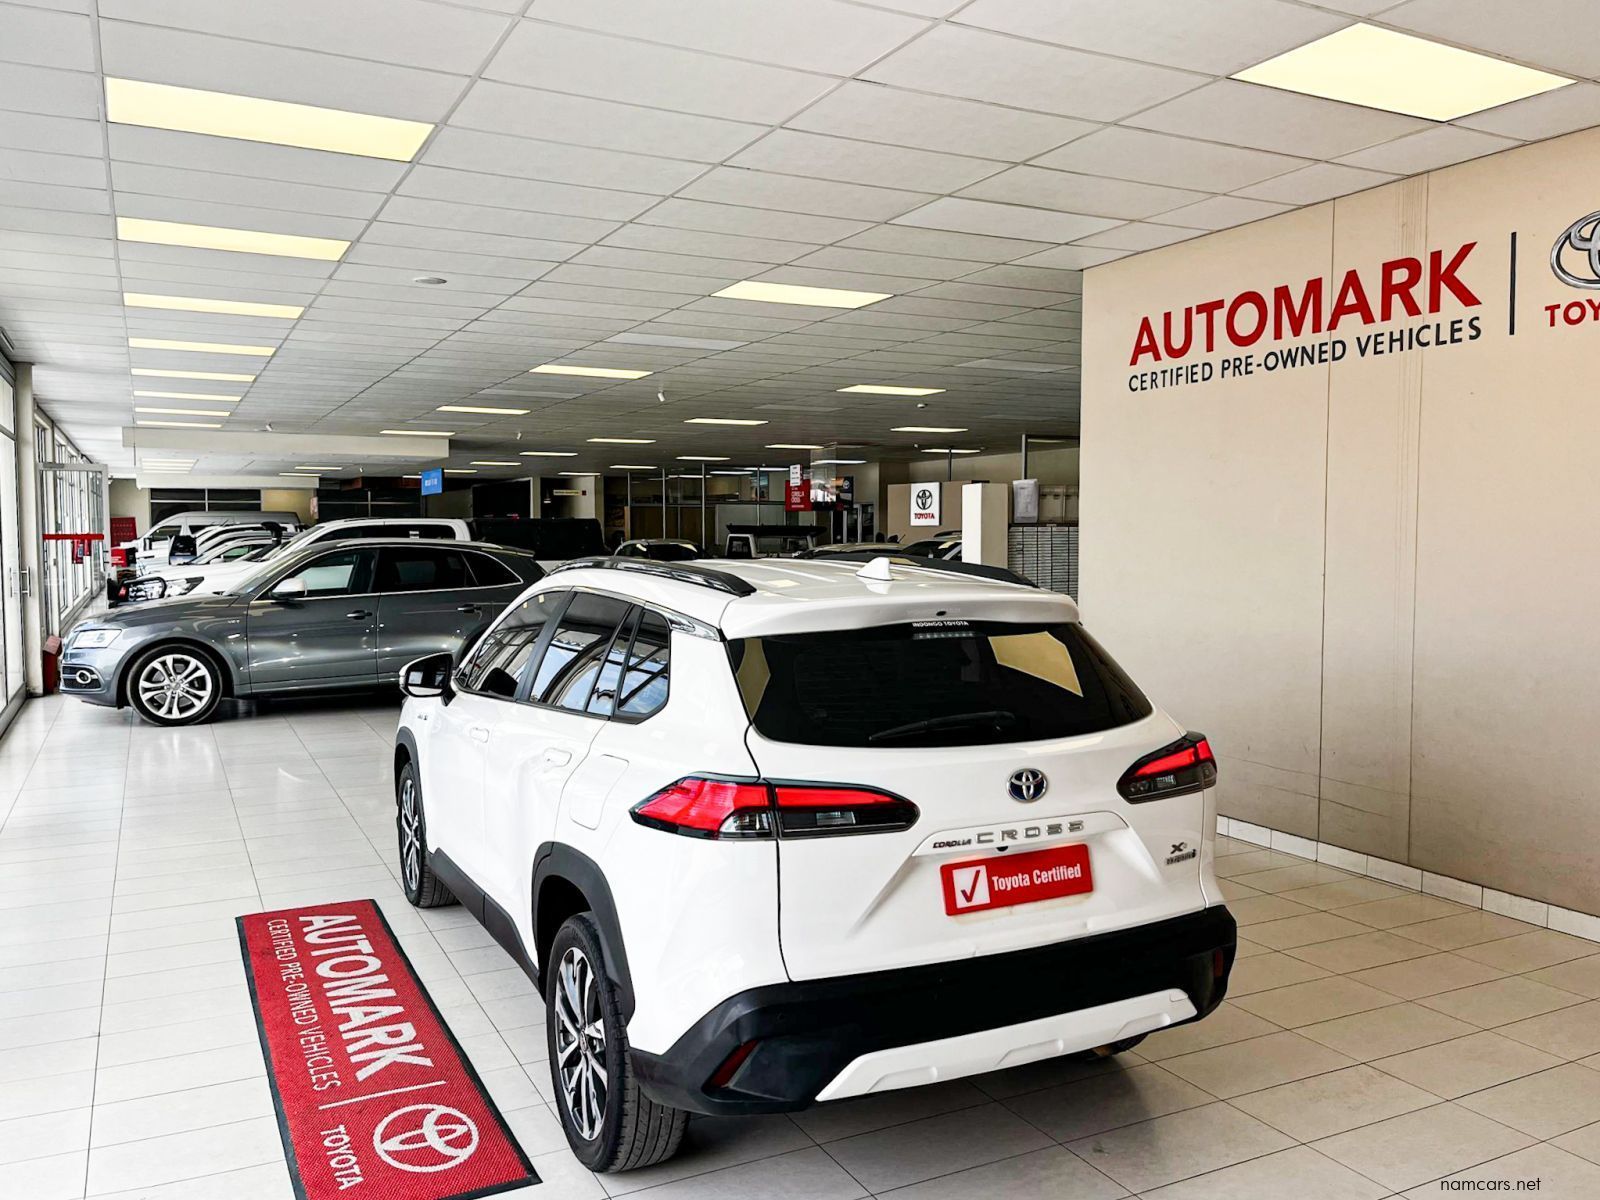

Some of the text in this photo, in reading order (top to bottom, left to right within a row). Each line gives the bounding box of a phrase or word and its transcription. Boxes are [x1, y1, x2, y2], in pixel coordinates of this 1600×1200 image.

[1129, 241, 1483, 366] AUTOMARK
[1544, 298, 1600, 327] TOY
[1128, 316, 1482, 392] CERTIFIED PRE-OWNED VEHICLES
[933, 820, 1084, 849] COROLLA CROSS
[992, 863, 1082, 891] Toyota Certified
[267, 918, 342, 1091] CERTIFIED PRE-OWNED VEHICLES
[298, 915, 434, 1082] AUTOMARK
[320, 1124, 364, 1190] TOYOTA
